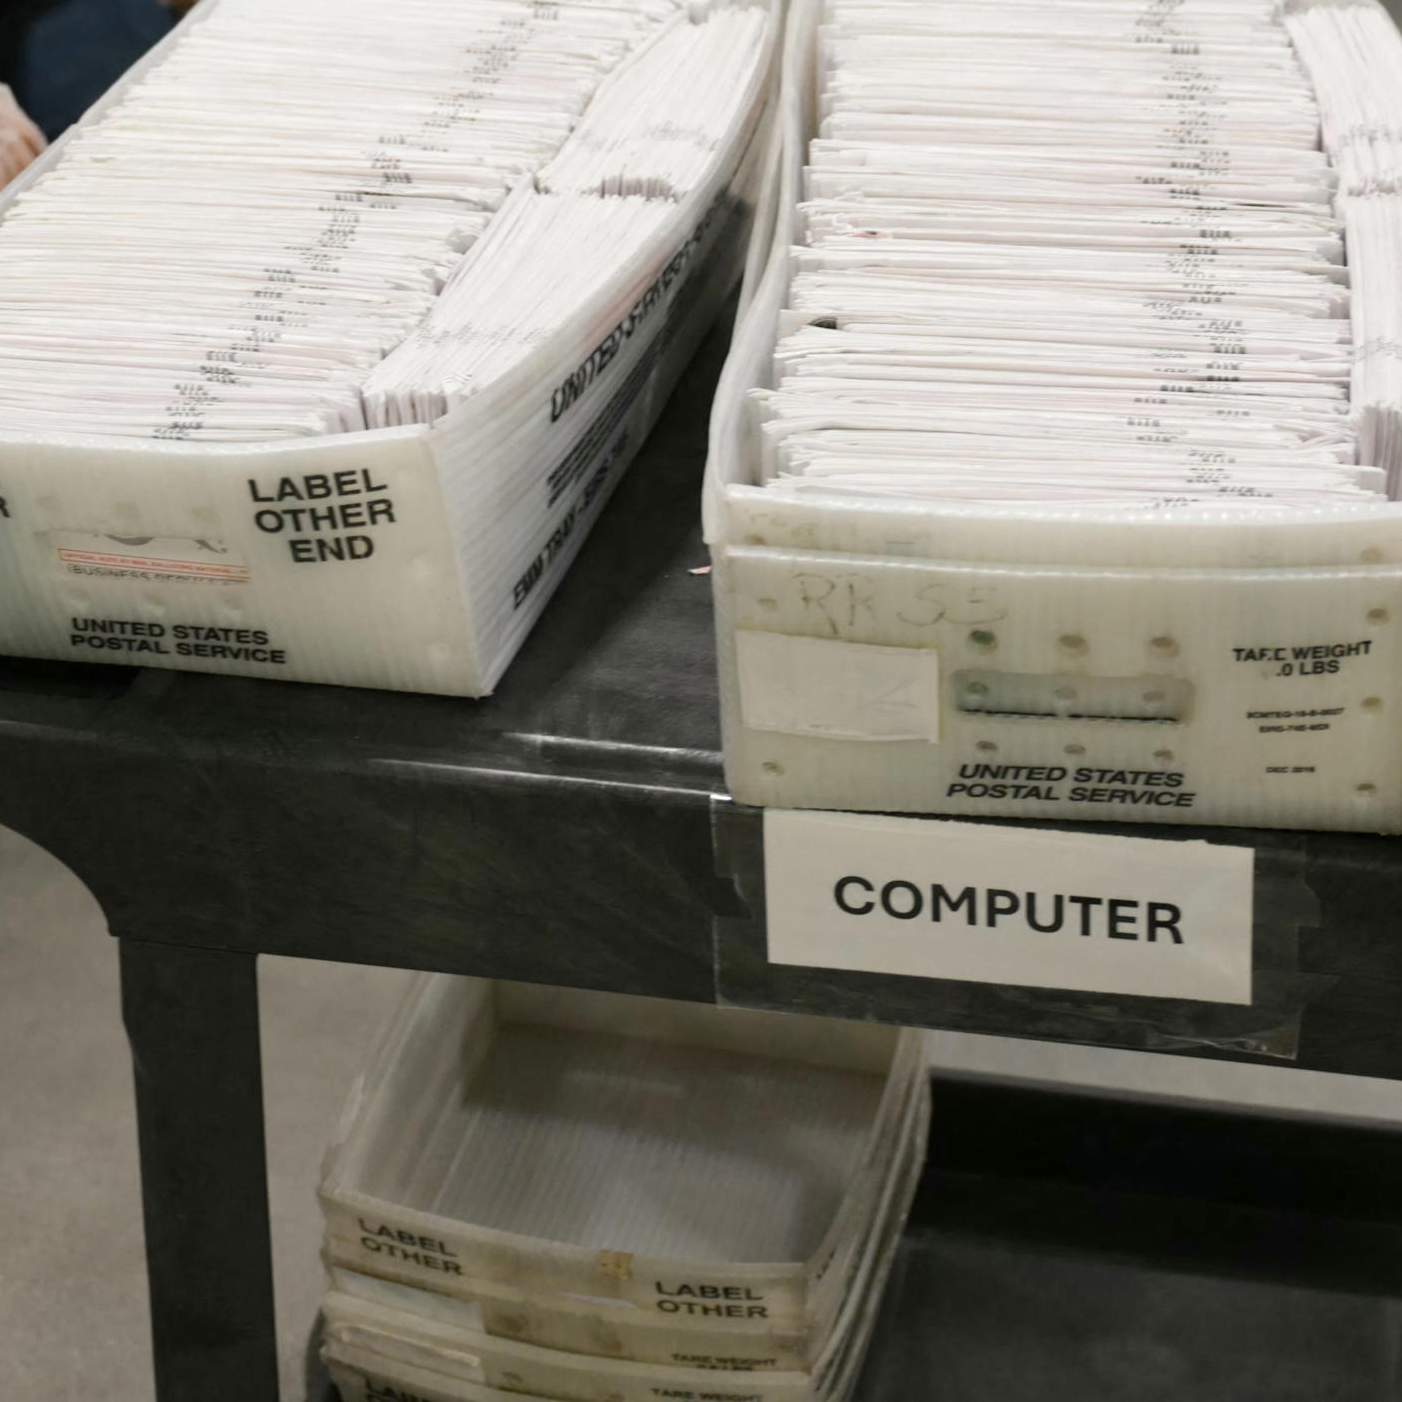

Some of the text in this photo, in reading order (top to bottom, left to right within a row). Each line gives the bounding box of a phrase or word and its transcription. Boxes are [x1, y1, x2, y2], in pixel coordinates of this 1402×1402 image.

[247, 468, 388, 503] LABEL
[254, 498, 396, 533] OTHER
[288, 534, 375, 563] END
[71, 617, 269, 645] UNITED STATES
[69, 634, 286, 665] POSTAL SERVICE
[1292, 640, 1373, 660] WEIGHT
[1299, 659, 1340, 676] LBS
[958, 763, 1185, 788] UNITED STATES
[946, 783, 1198, 808] POSTAL SERVICE
[833, 875, 1185, 945] COMPUTER
[357, 1218, 458, 1258] LABEL
[360, 1237, 464, 1276] OTHER
[655, 1281, 764, 1301] LABEL
[656, 1299, 769, 1319] OTHER
